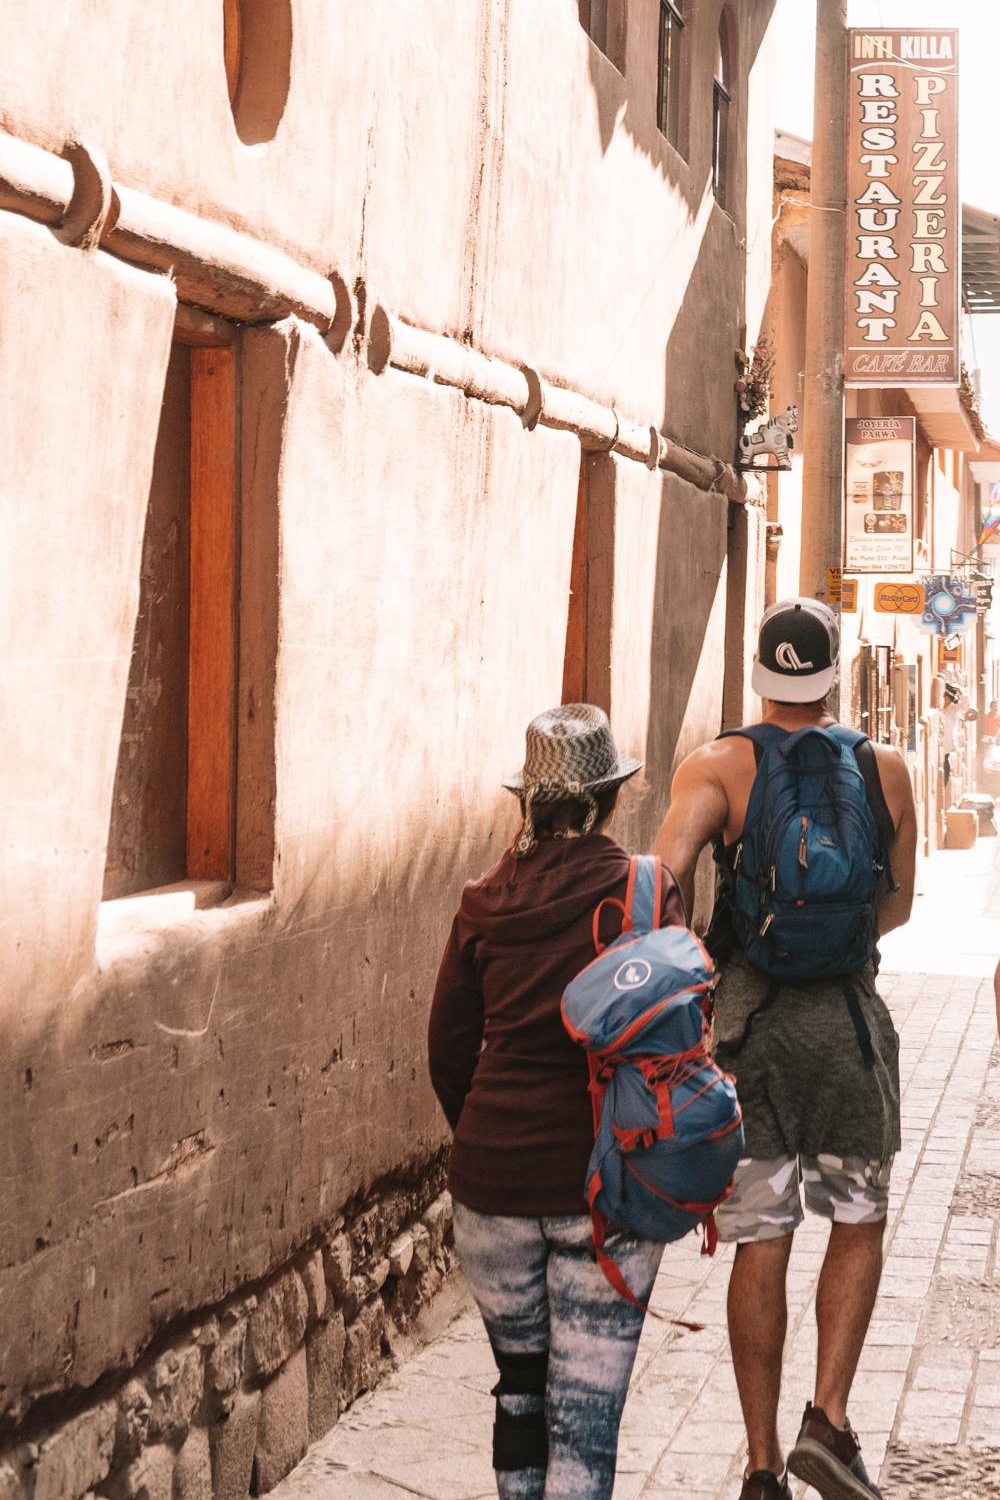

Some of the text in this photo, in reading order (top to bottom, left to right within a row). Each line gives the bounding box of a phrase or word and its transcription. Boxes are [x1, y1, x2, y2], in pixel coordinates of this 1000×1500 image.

[854, 35, 953, 59] INTI KILLA
[853, 73, 901, 342] RESTAURANT
[906, 75, 951, 342] PIZZERIA
[852, 350, 950, 373] CAFÉ BAR
[861, 430, 897, 439] PARWA
[880, 594, 918, 603] MasterCard
